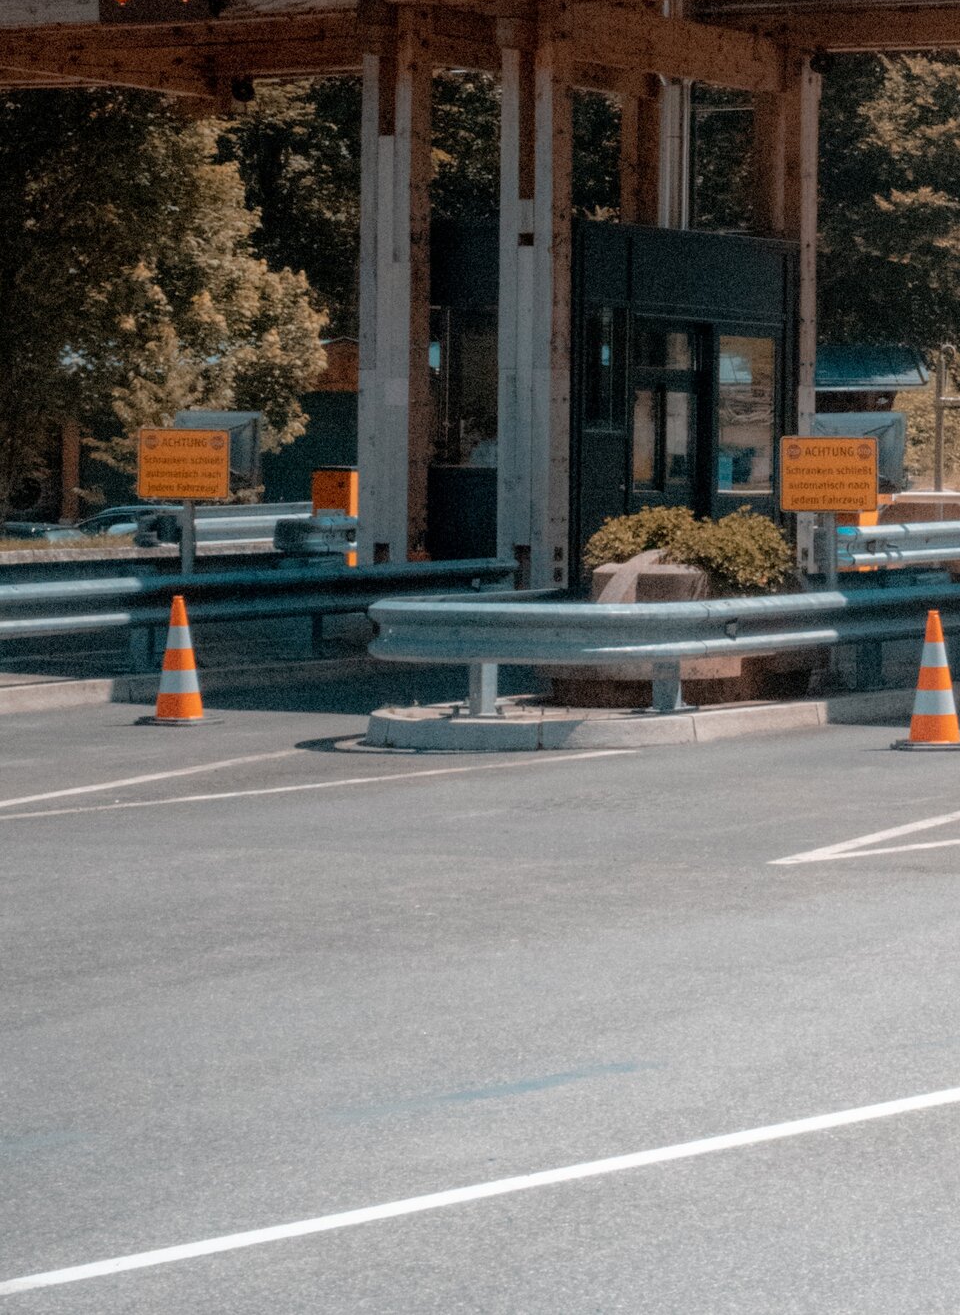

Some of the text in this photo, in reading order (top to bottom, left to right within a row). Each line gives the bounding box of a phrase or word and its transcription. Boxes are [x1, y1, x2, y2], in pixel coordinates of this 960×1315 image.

[161, 437, 207, 448] ACHTUNG
[805, 446, 854, 457] ACHTUNG
[789, 481, 845, 489] automatisch
[791, 495, 819, 505] jedem
